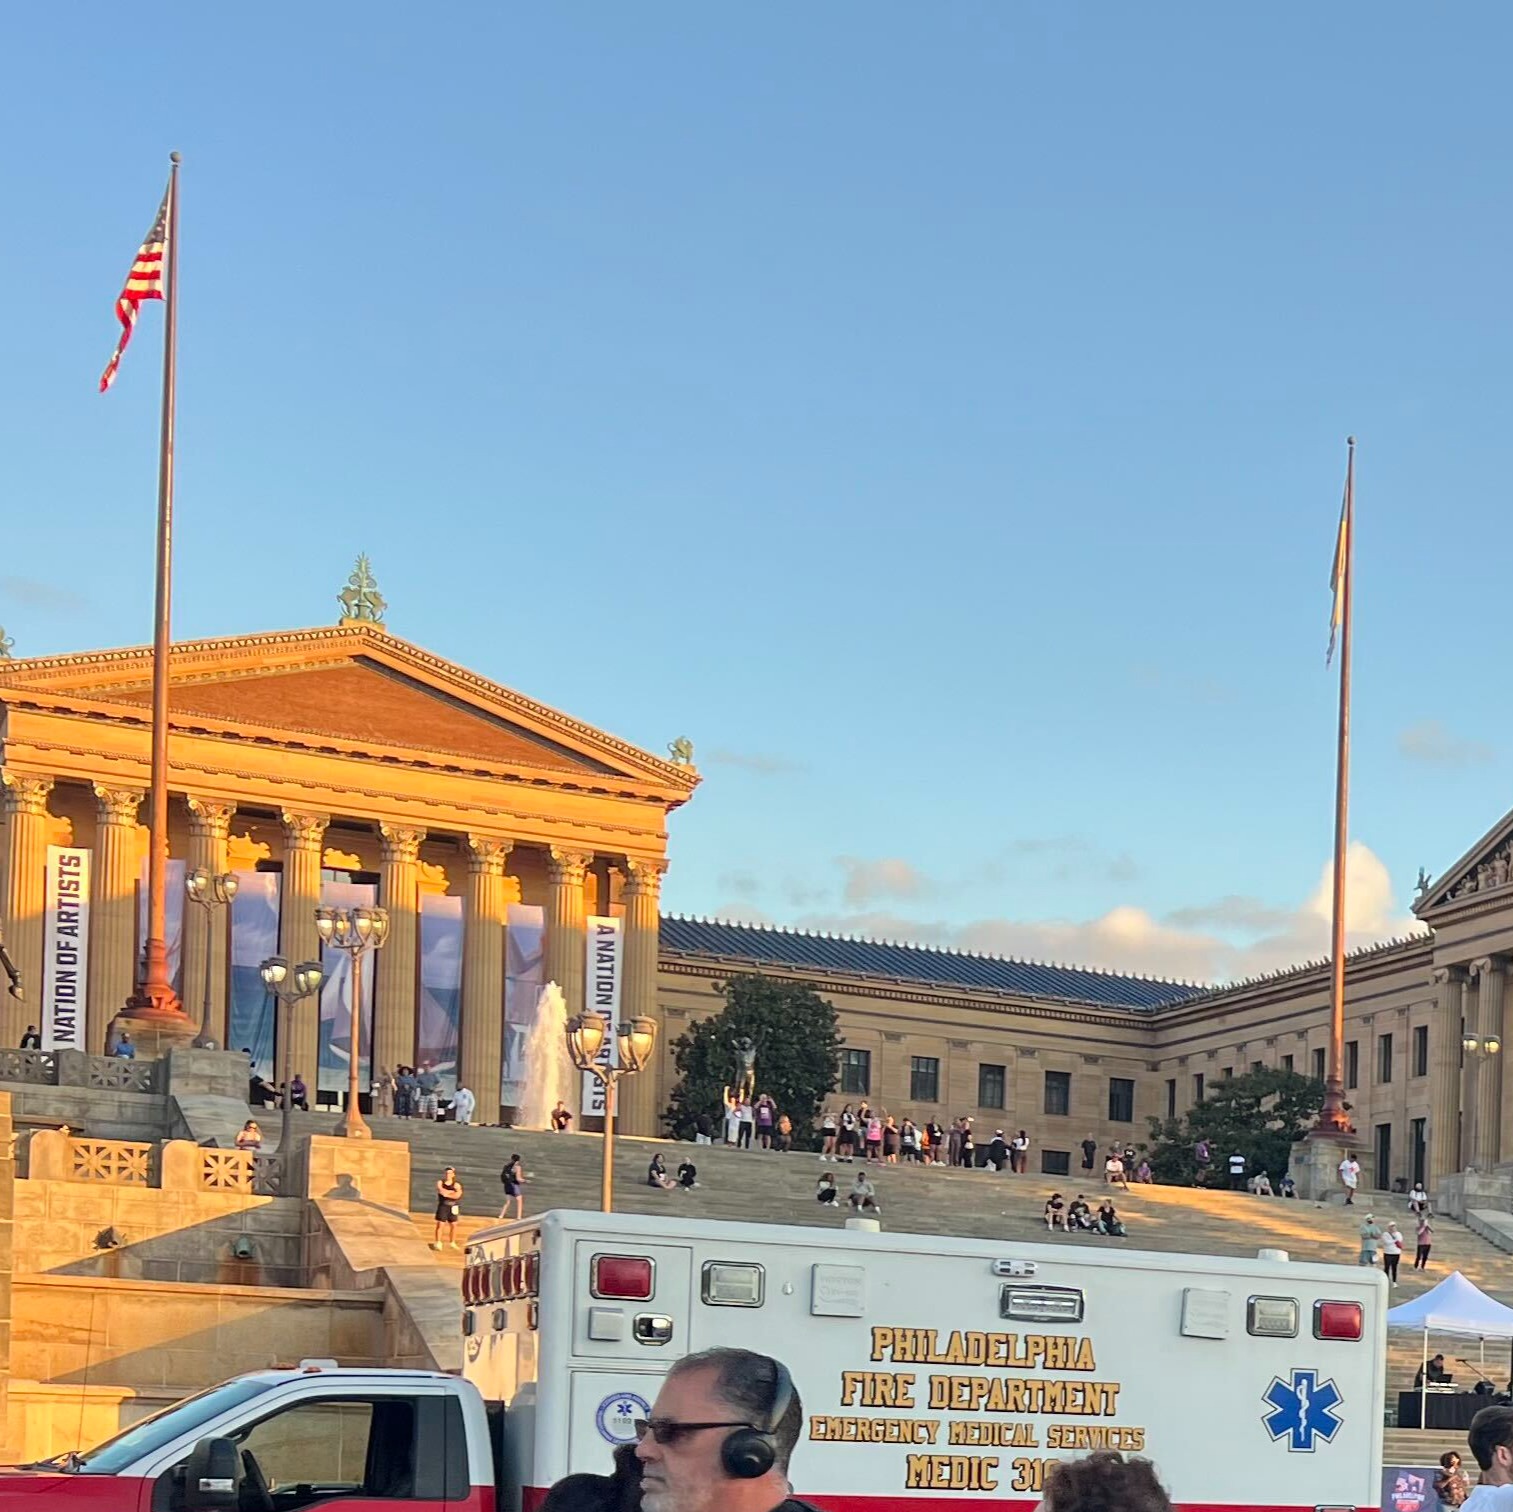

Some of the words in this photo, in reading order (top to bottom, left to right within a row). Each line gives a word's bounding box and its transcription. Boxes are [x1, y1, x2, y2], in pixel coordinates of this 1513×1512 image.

[57, 854, 81, 938] ARTISTS
[597, 923, 615, 936] A
[56, 940, 77, 966] OF
[596, 940, 615, 1006] NATION
[53, 970, 78, 1043] NATION
[871, 1326, 1097, 1372] PHILADELPHIA
[841, 1371, 917, 1409] FIRE
[929, 1374, 1121, 1417] DEPARTMENT
[809, 1415, 940, 1445] EMERGENCY
[948, 1420, 1039, 1448] MEDICAL
[1046, 1423, 1145, 1451] SERVICES
[905, 1454, 1000, 1491] MEDIC
